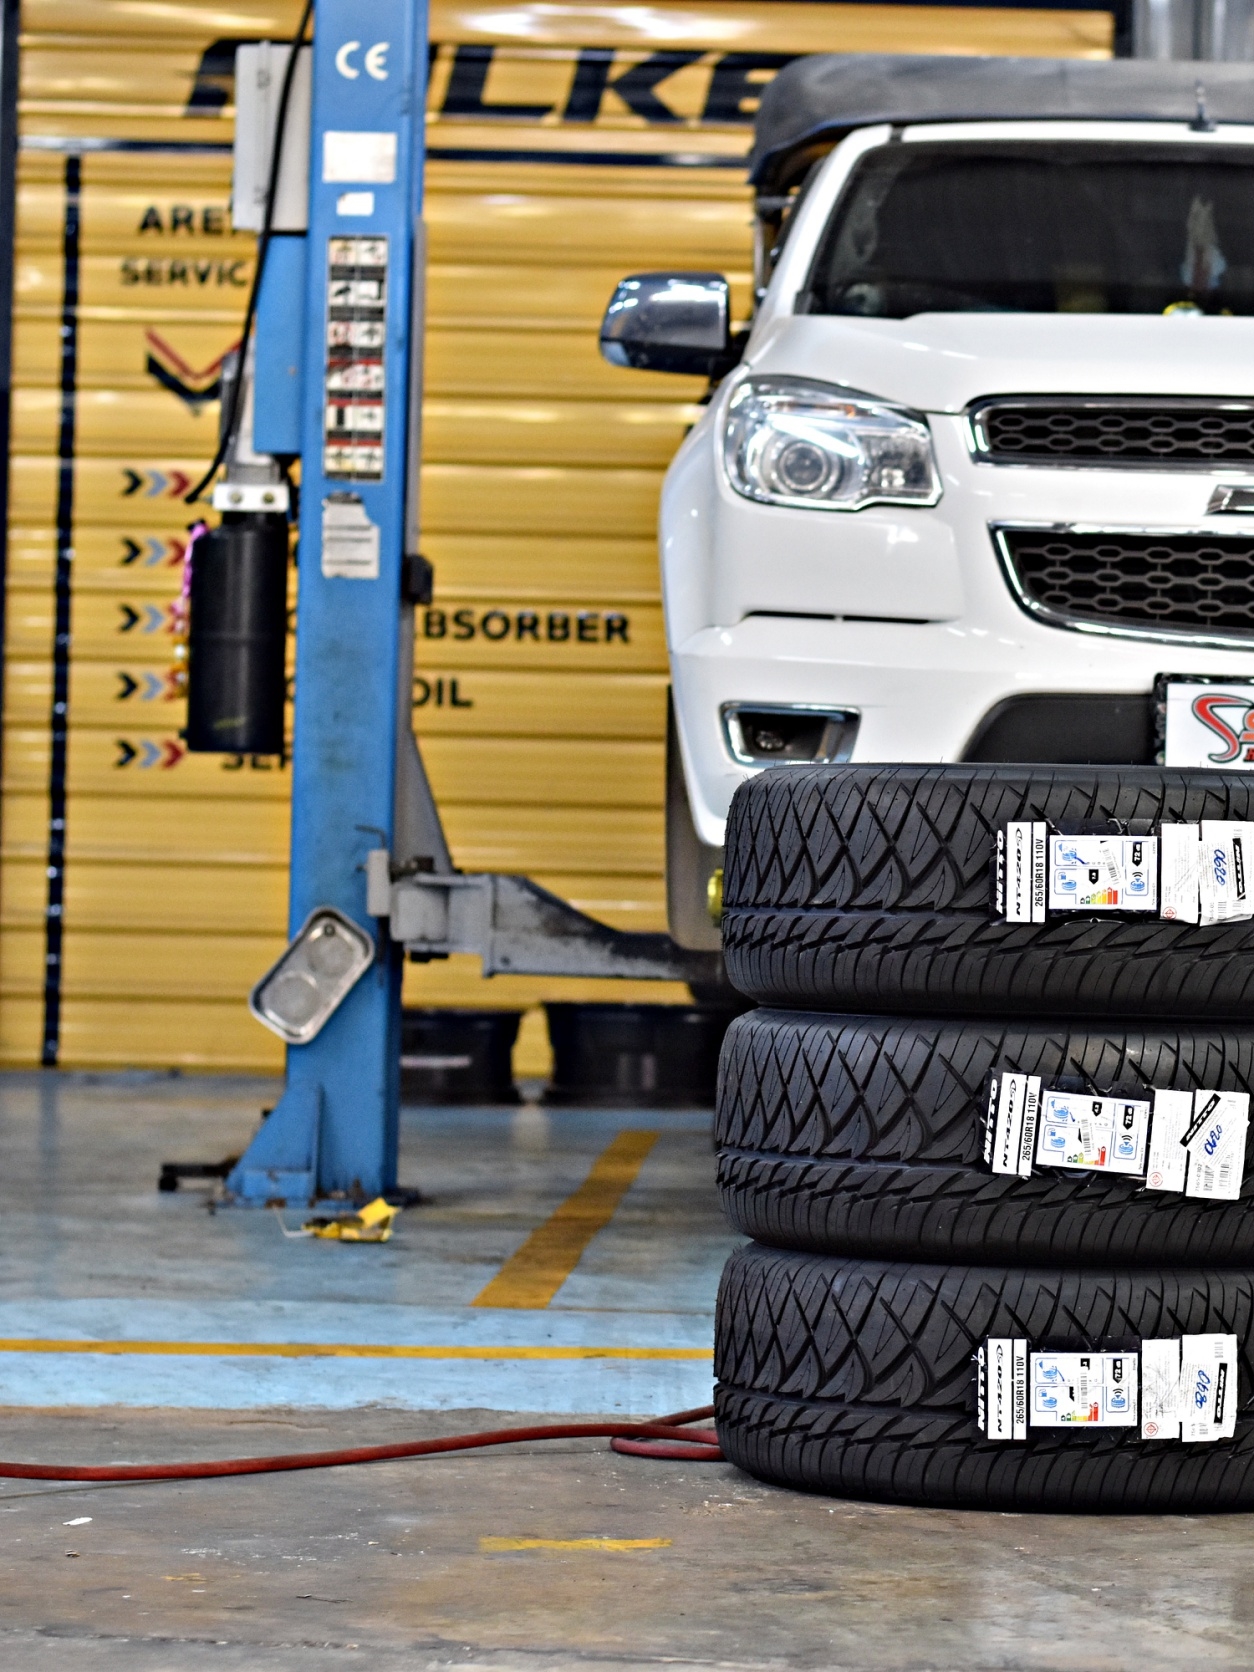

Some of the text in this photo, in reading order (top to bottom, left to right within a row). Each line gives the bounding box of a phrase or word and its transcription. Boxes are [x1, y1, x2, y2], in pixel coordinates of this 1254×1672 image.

[138, 206, 237, 236] ARE
[121, 257, 248, 286] SERVIC
[416, 609, 632, 644] BSORBER
[1035, 838, 1044, 907] 265/60R18 110V
[1022, 1092, 1038, 1161] 265/60R18 110V
[1015, 1355, 1025, 1424] 265/60R18 110V
